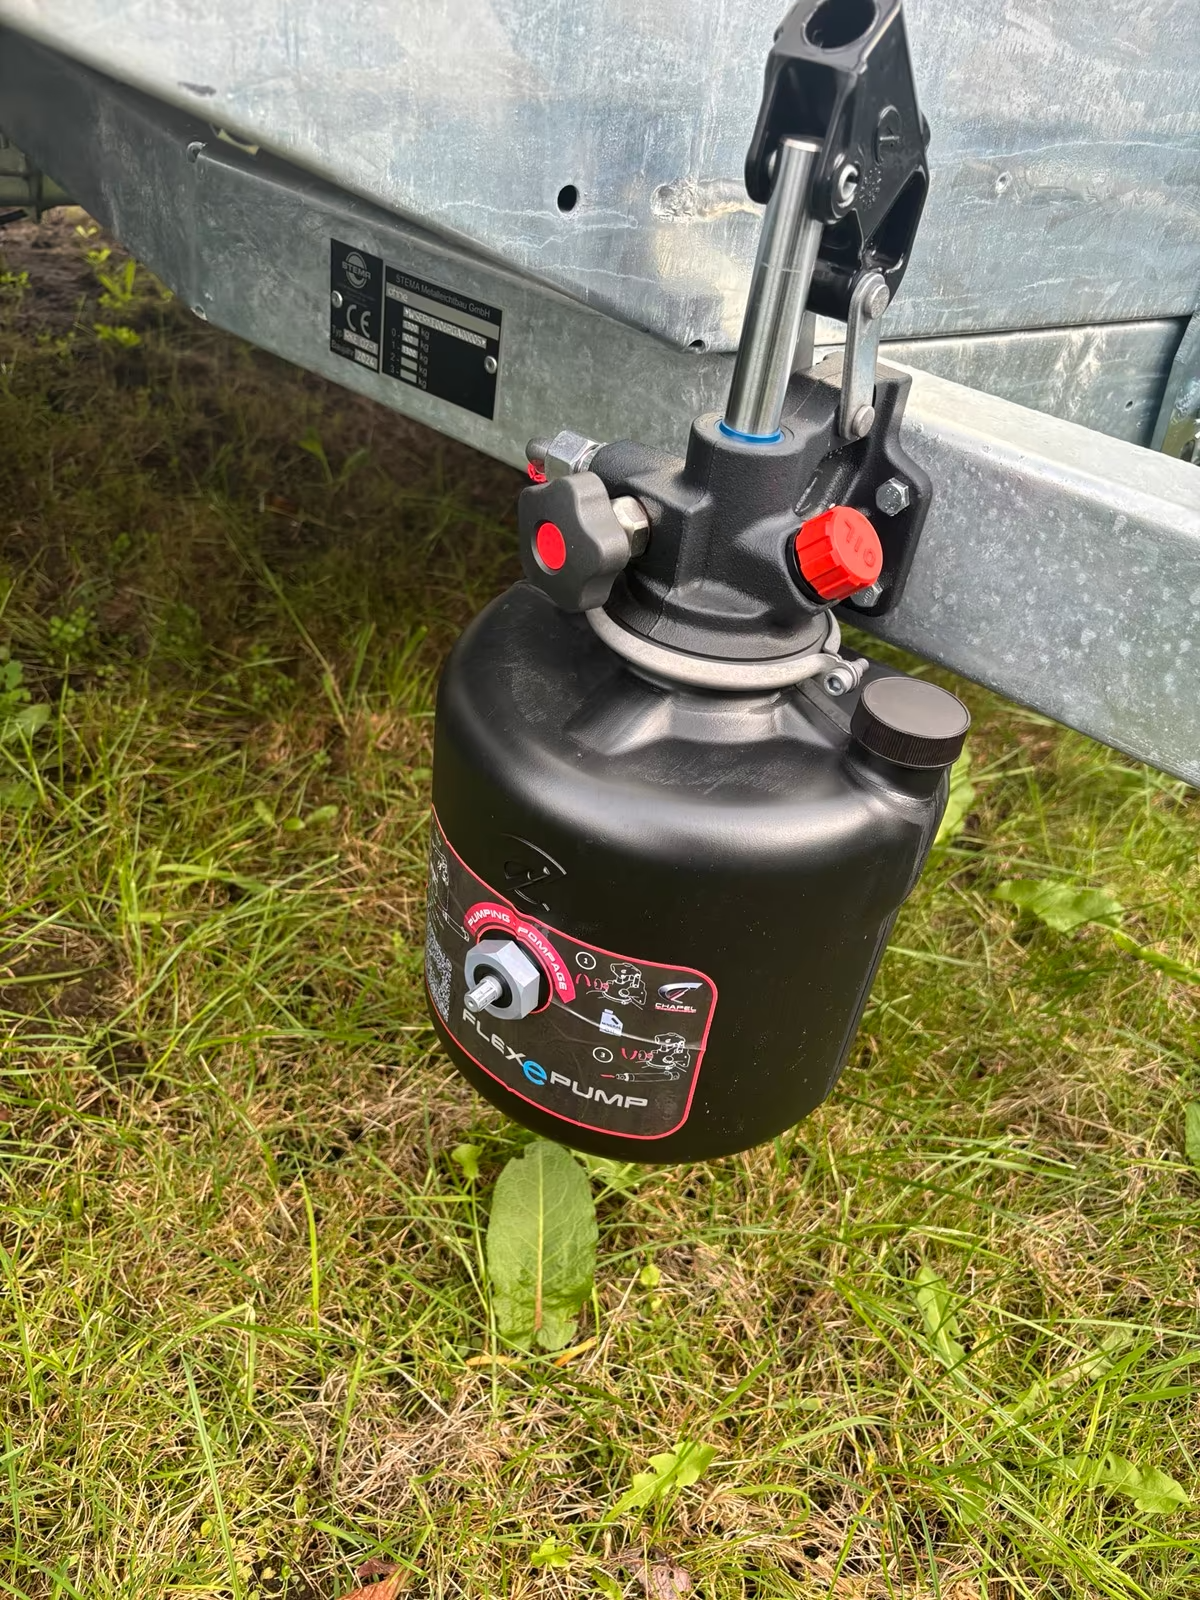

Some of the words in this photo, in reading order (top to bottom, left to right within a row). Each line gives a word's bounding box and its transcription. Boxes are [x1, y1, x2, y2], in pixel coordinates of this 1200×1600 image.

[342, 260, 371, 280] STEMA
[396, 273, 420, 292] STEMA
[420, 284, 468, 310] Metalleichtbau
[468, 302, 491, 319] GmbH
[346, 304, 371, 339] CE
[420, 327, 430, 340] kg
[420, 340, 429, 353] kg
[356, 350, 375, 367] 2024
[419, 352, 429, 365] kg
[419, 365, 428, 377] kg
[418, 377, 427, 390] kg
[844, 520, 877, 569] OIL
[467, 908, 511, 927] PUMPING
[517, 926, 568, 991] POMPAGE
[654, 1002, 697, 1013] CHAPEL
[600, 1051, 606, 1059] 3
